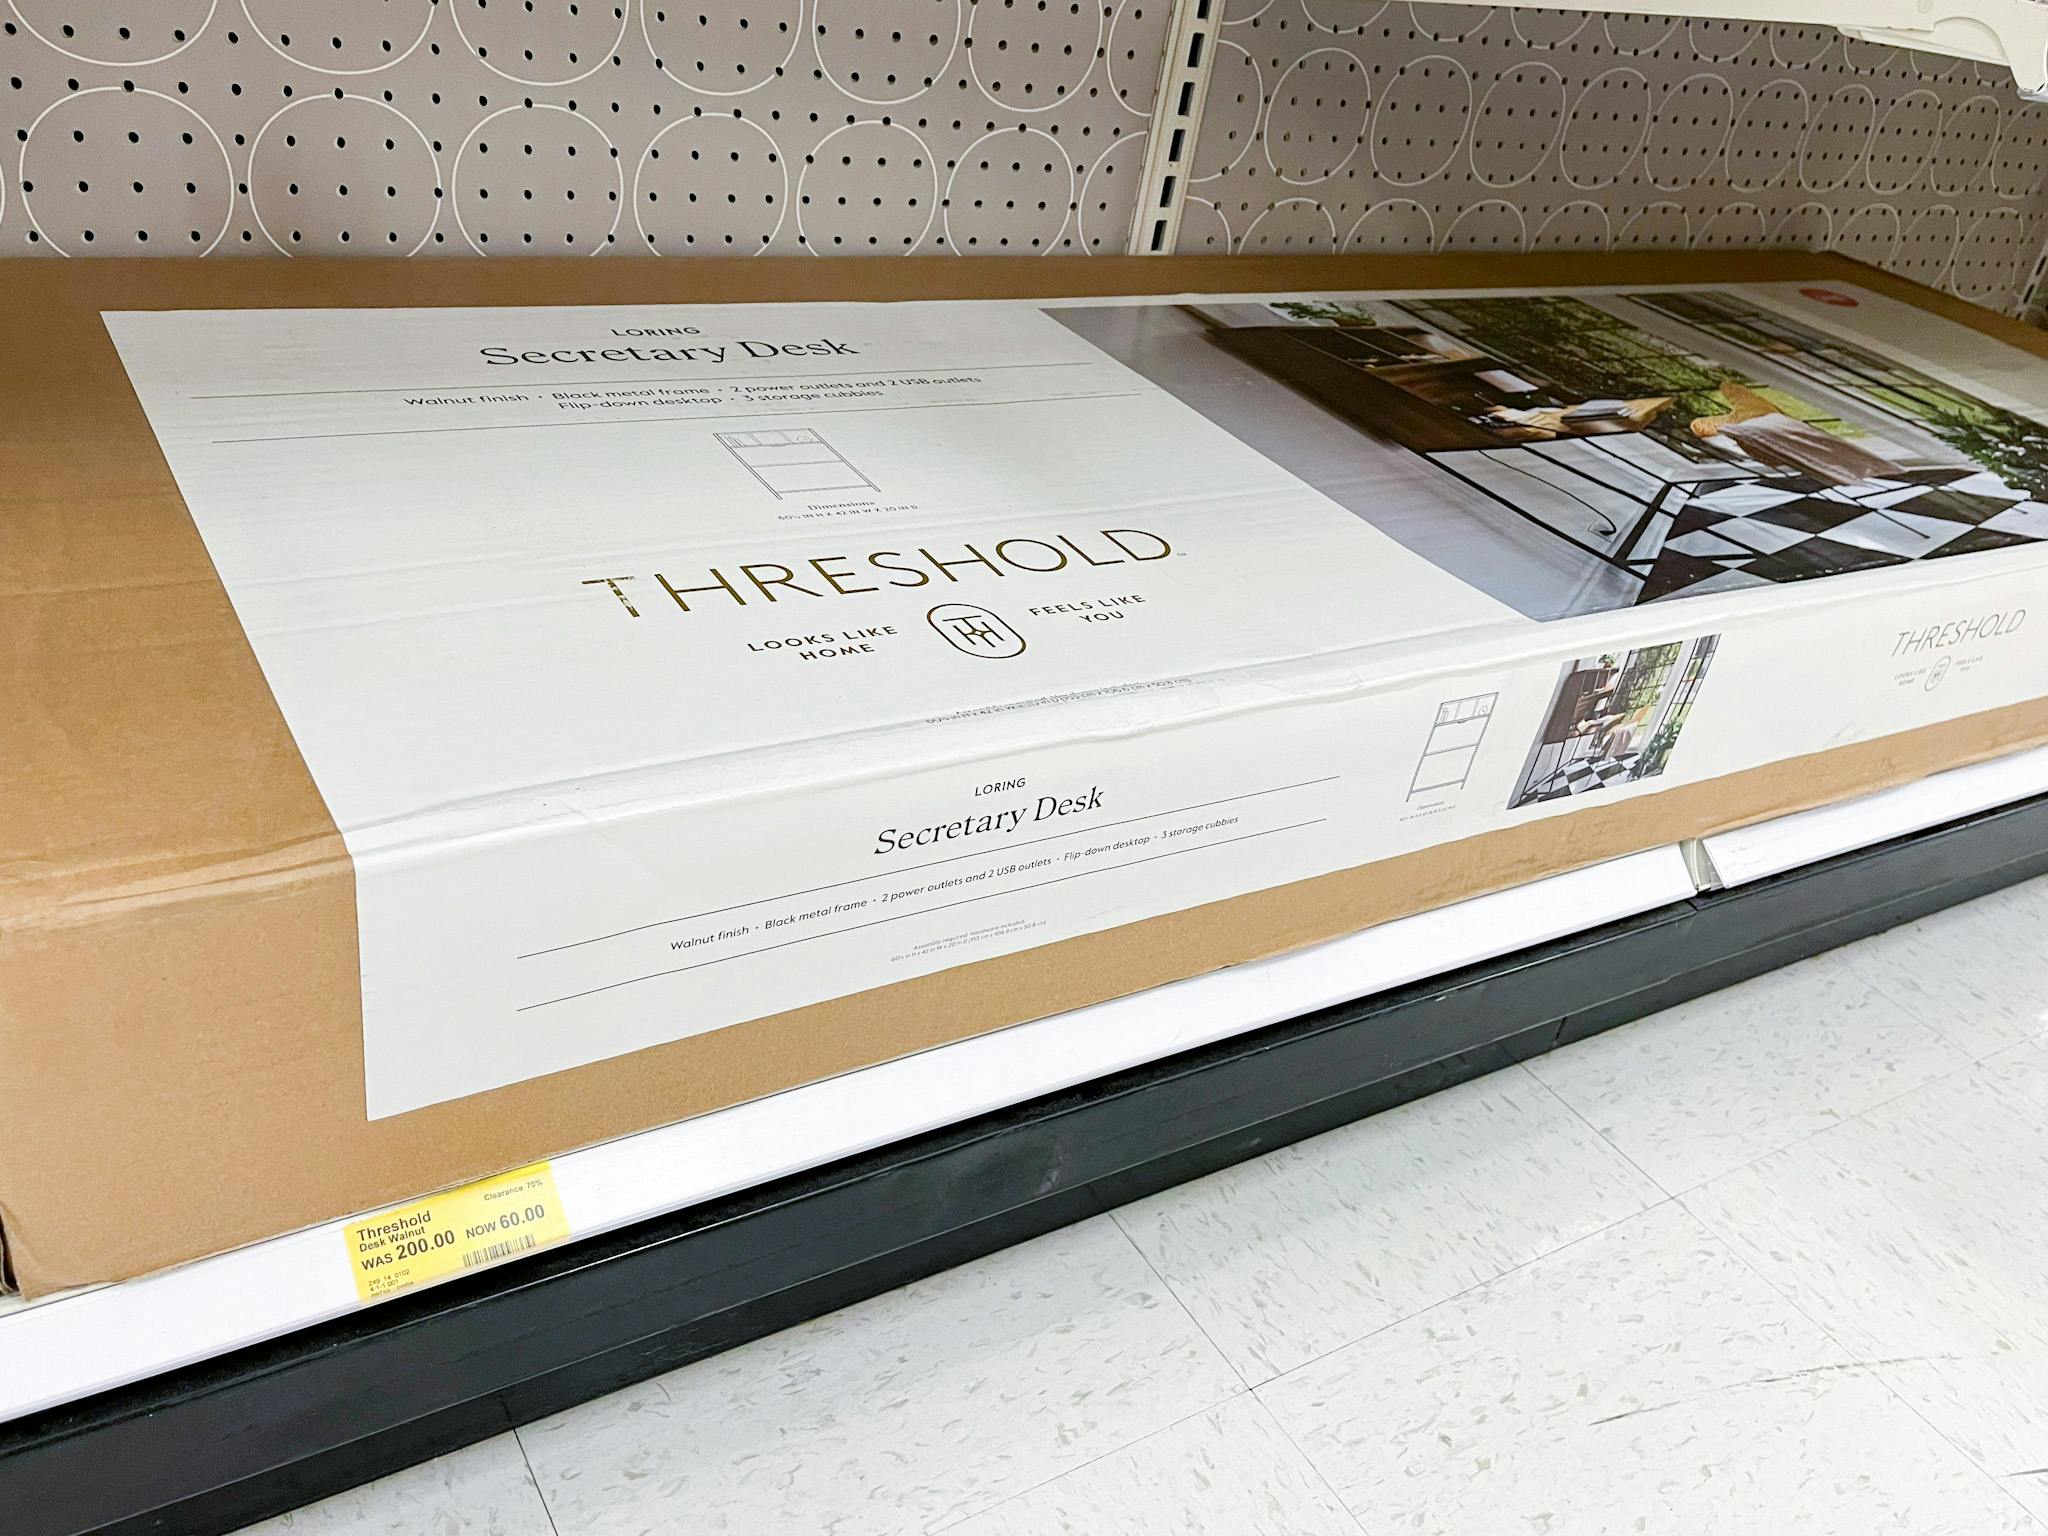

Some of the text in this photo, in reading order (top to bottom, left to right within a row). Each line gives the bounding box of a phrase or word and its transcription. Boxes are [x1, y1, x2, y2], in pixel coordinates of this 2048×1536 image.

[611, 326, 700, 337] LORING
[480, 338, 861, 365] Secretary Desk
[403, 396, 473, 406] Walnut
[479, 394, 529, 403] finish
[552, 391, 600, 400] Black
[604, 388, 656, 398] metal
[658, 387, 710, 397] frame
[729, 385, 742, 393] 2
[744, 384, 795, 395] power
[800, 382, 852, 391] outlets
[855, 379, 886, 388] and
[899, 377, 930, 386] USB
[933, 376, 983, 384] outlets
[558, 399, 650, 410] Flip-down
[652, 396, 722, 407] desktop
[757, 392, 821, 402] storage
[824, 388, 884, 398] cubbies
[808, 501, 875, 511] Dimensions
[581, 529, 1171, 618] THRESHOLD
[1029, 594, 1146, 616] FEELS LIKE
[1079, 610, 1124, 623] YOU
[747, 625, 898, 652] LOOKS LIKE
[1892, 609, 2026, 657] THRESHOLD
[800, 643, 875, 660] HOME
[974, 777, 1027, 797] LORING
[874, 785, 1104, 855] Secretary Desk
[670, 816, 1240, 951] Walnut finish Black metal frame 2 power outlets and 2 USB outlets Flip-down desktop 3 storage cubbies
[484, 1178, 543, 1201] Clearance 70%
[357, 1210, 431, 1242] Threshold
[359, 1225, 426, 1253] Desk Walnut
[361, 1204, 545, 1270] WAS 200.00 NOW 60.00
